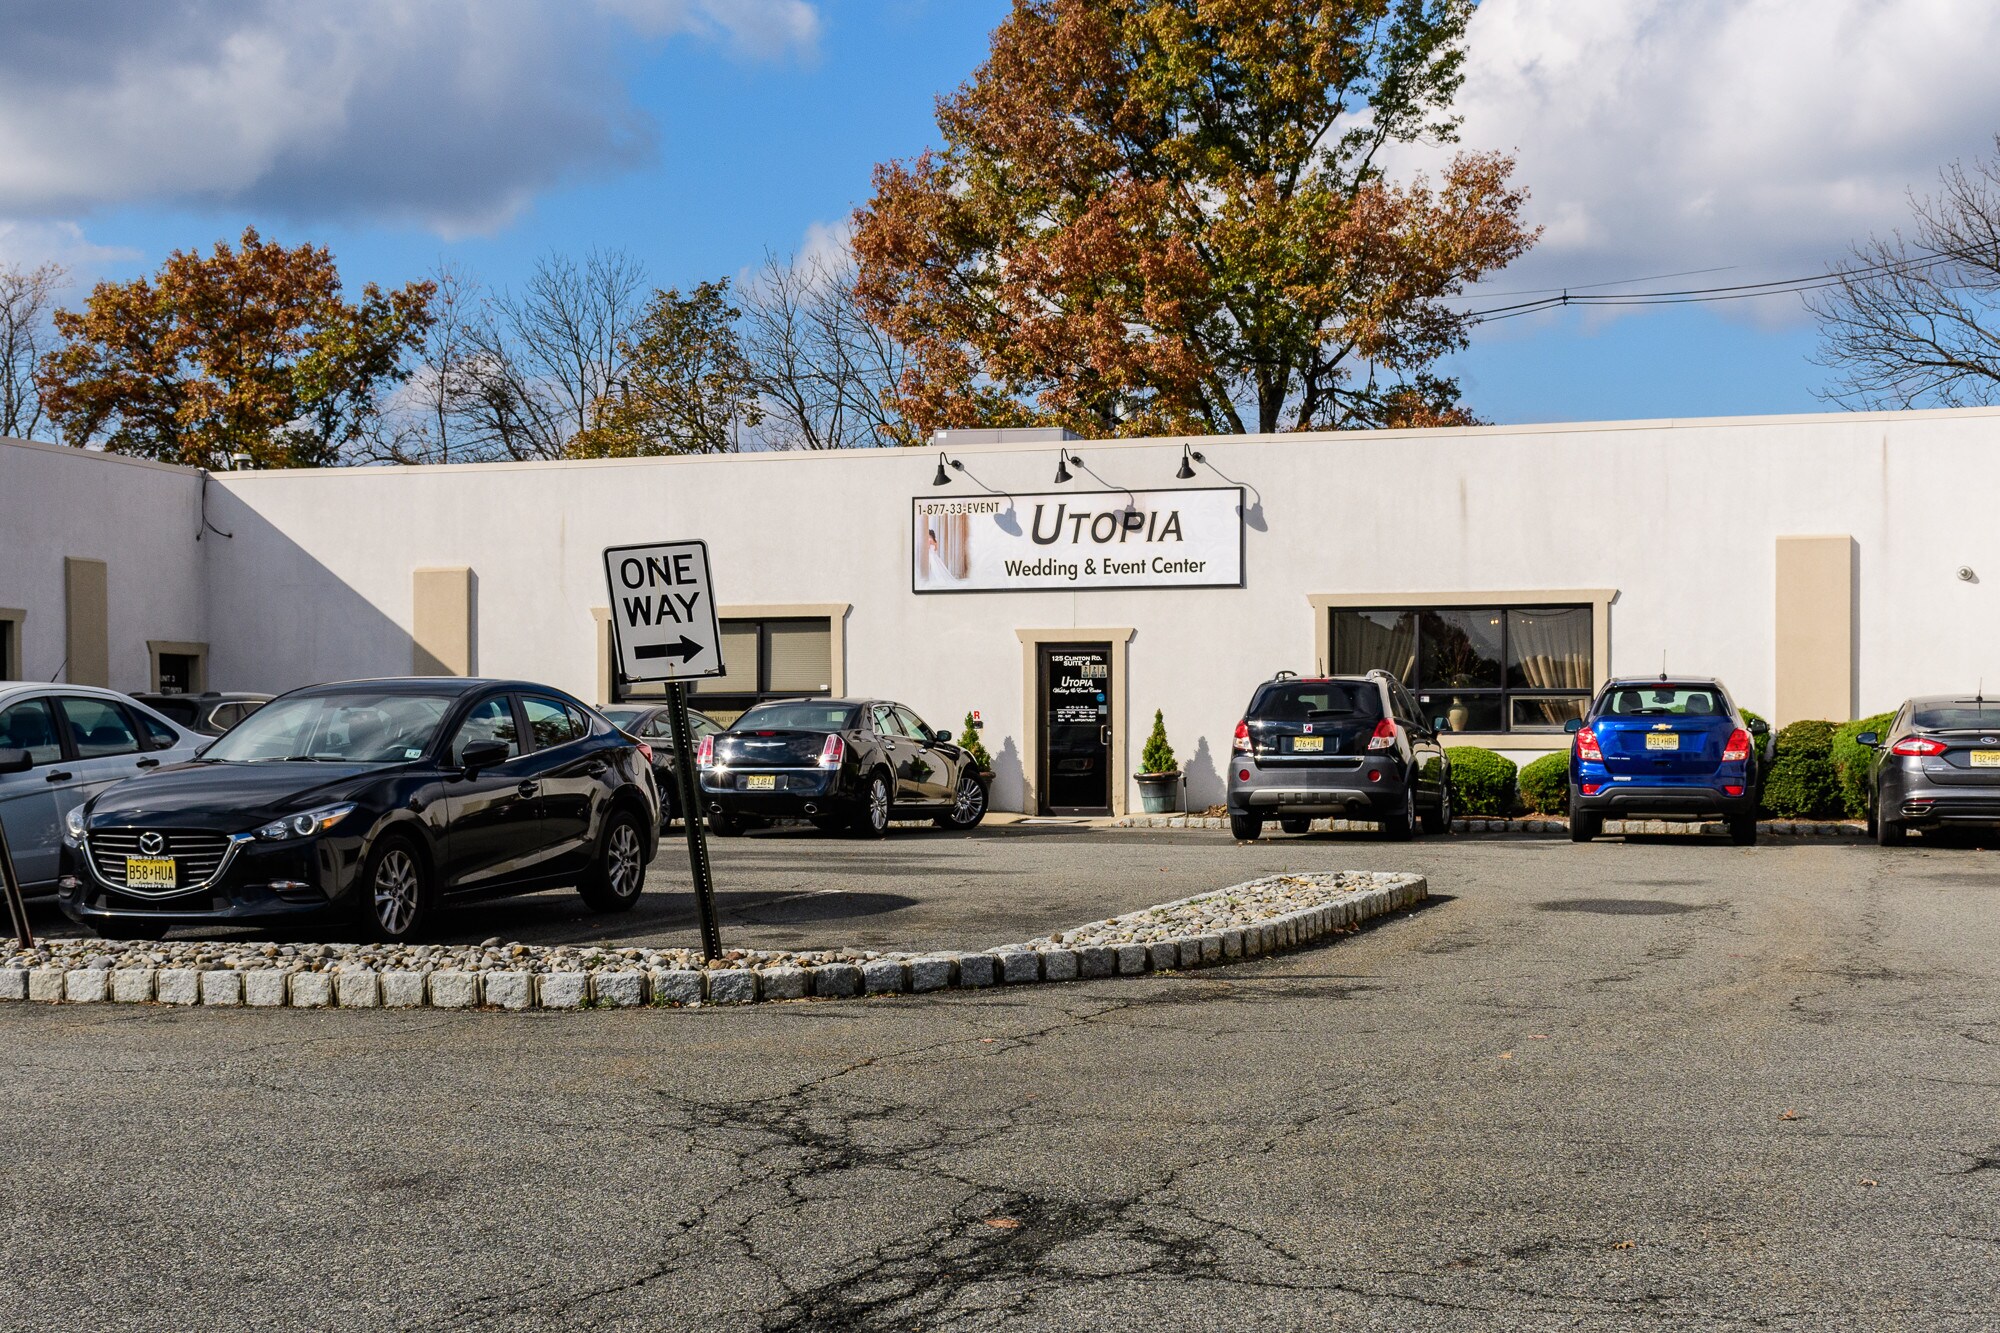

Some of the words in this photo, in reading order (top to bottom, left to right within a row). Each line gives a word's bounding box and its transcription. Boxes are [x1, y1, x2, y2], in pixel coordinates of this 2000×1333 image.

[918, 502, 1000, 515] 1-877-33-EVENT
[1031, 503, 1184, 545] UTOPIA
[620, 553, 698, 589] ONE
[1004, 557, 1078, 581] Wedding
[1084, 558, 1097, 575] &
[1103, 558, 1147, 575] Event
[1151, 556, 1207, 574] Center
[622, 591, 701, 627] WAY
[1061, 675, 1094, 687] UTOPIA
[973, 710, 981, 720] R
[129, 865, 148, 880] B58
[154, 865, 174, 881] HUA
